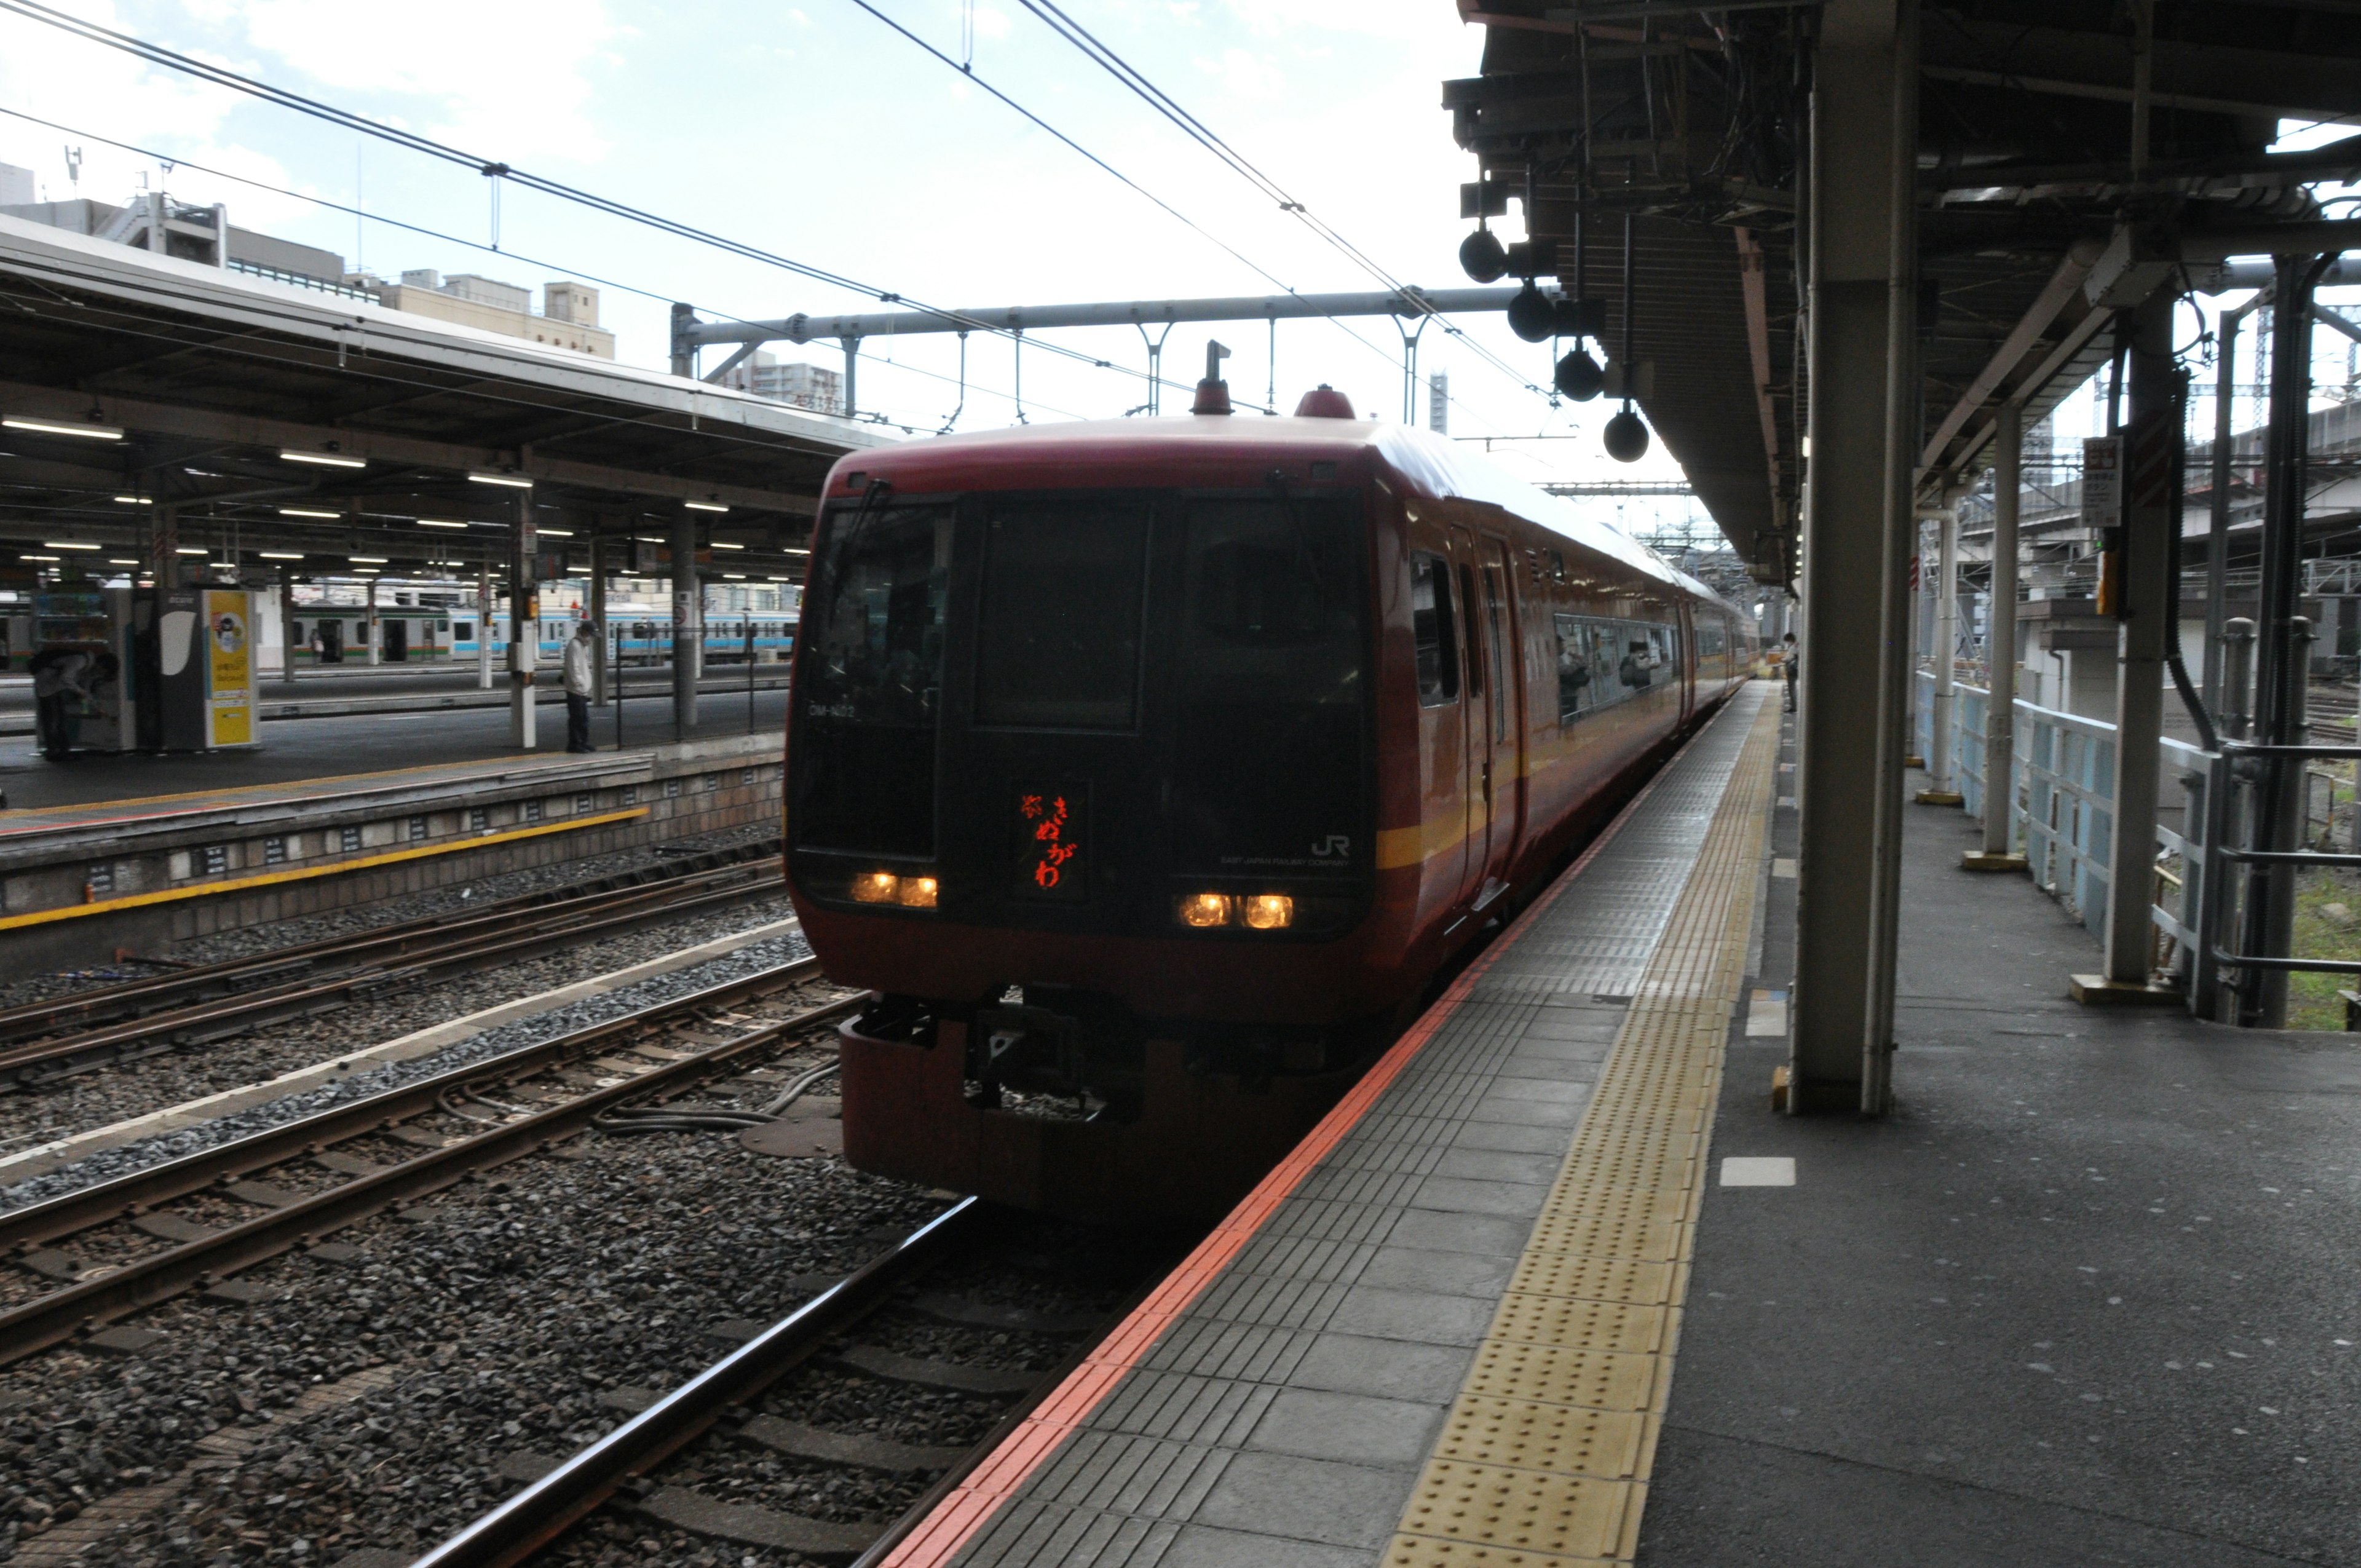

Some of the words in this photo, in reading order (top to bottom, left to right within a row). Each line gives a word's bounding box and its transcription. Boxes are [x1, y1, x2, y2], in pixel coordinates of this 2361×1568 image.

[1035, 796, 1078, 887] きぬがわ
[1311, 834, 1350, 857] JR
